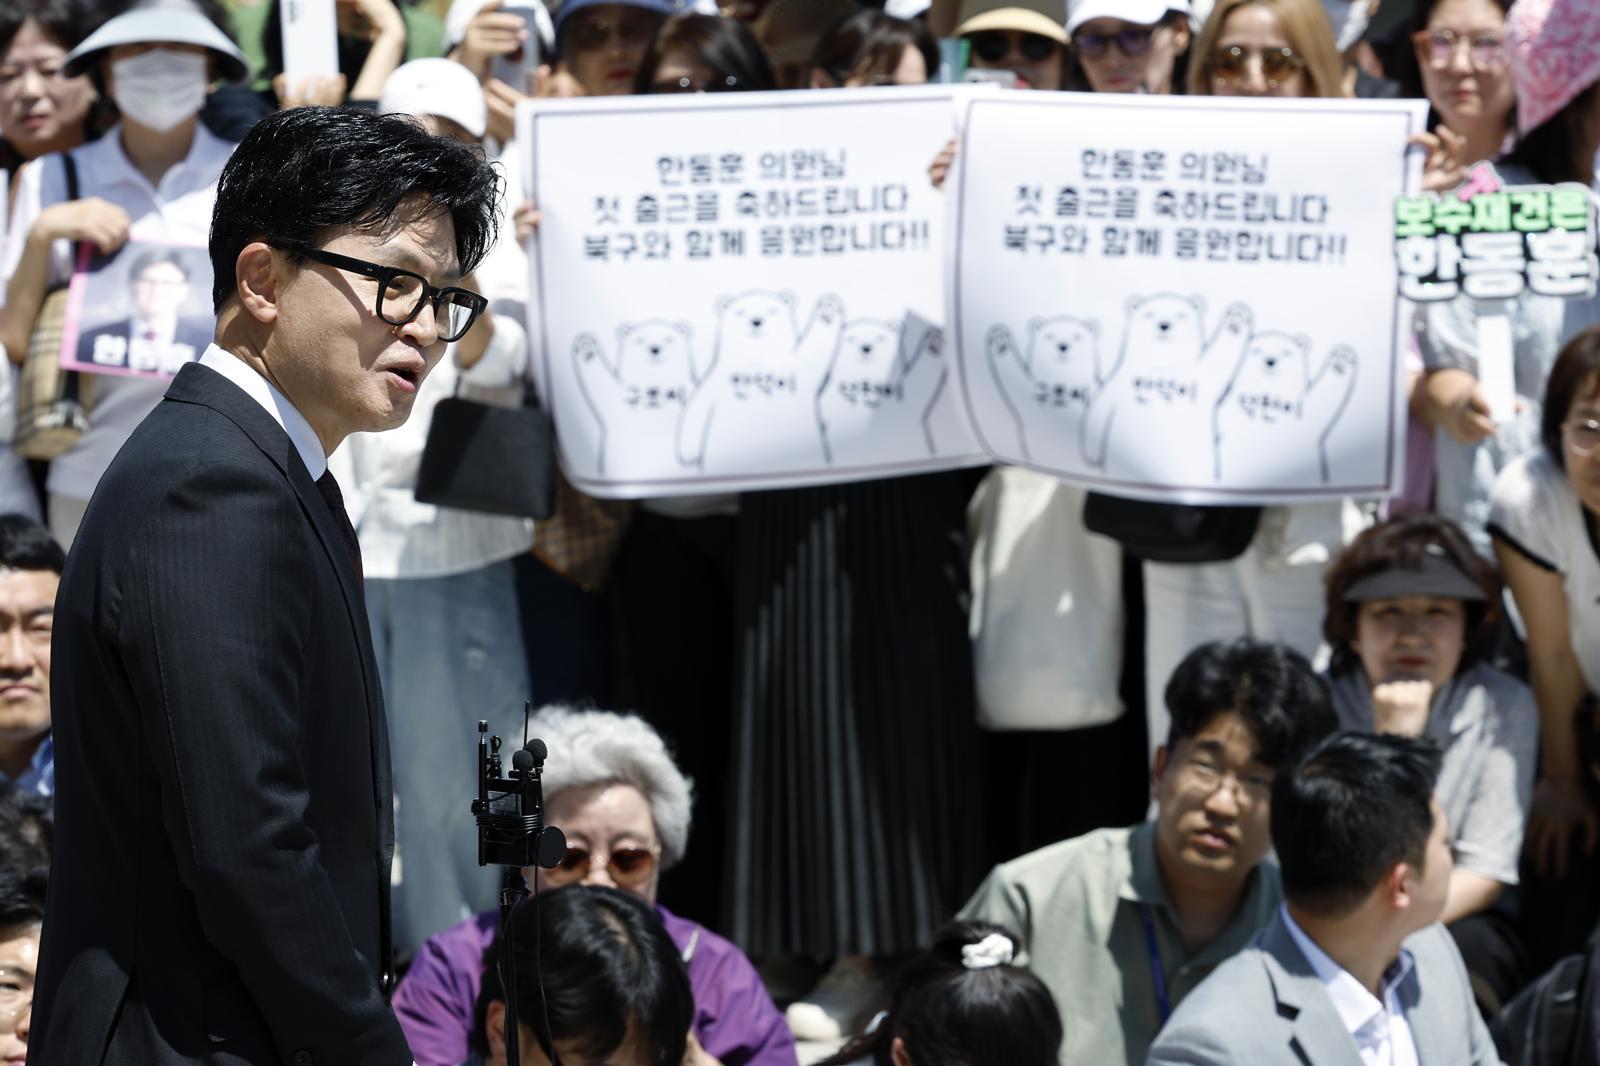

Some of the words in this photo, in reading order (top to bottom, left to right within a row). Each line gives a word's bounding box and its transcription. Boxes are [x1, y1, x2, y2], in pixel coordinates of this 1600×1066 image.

[656, 152, 744, 186] 한동훈
[759, 149, 846, 181] 의원님
[1081, 149, 1166, 181] 한동훈
[1179, 151, 1268, 185] 의원님
[595, 195, 620, 224] 첫
[635, 192, 719, 224] 출근을
[737, 184, 909, 219] 축하드립니다
[1016, 185, 1042, 215] 첫
[1055, 185, 1139, 220] 출근을
[1154, 187, 1329, 225] 축하드립니다
[584, 231, 672, 261] 북구와
[685, 229, 745, 260] 함께
[759, 219, 929, 257] 응원합니다!!
[1004, 224, 1089, 254] 북구와
[1102, 225, 1162, 257] 함께
[1174, 227, 1347, 263] 응원합니다!!
[1398, 229, 1588, 300] 한동훈
